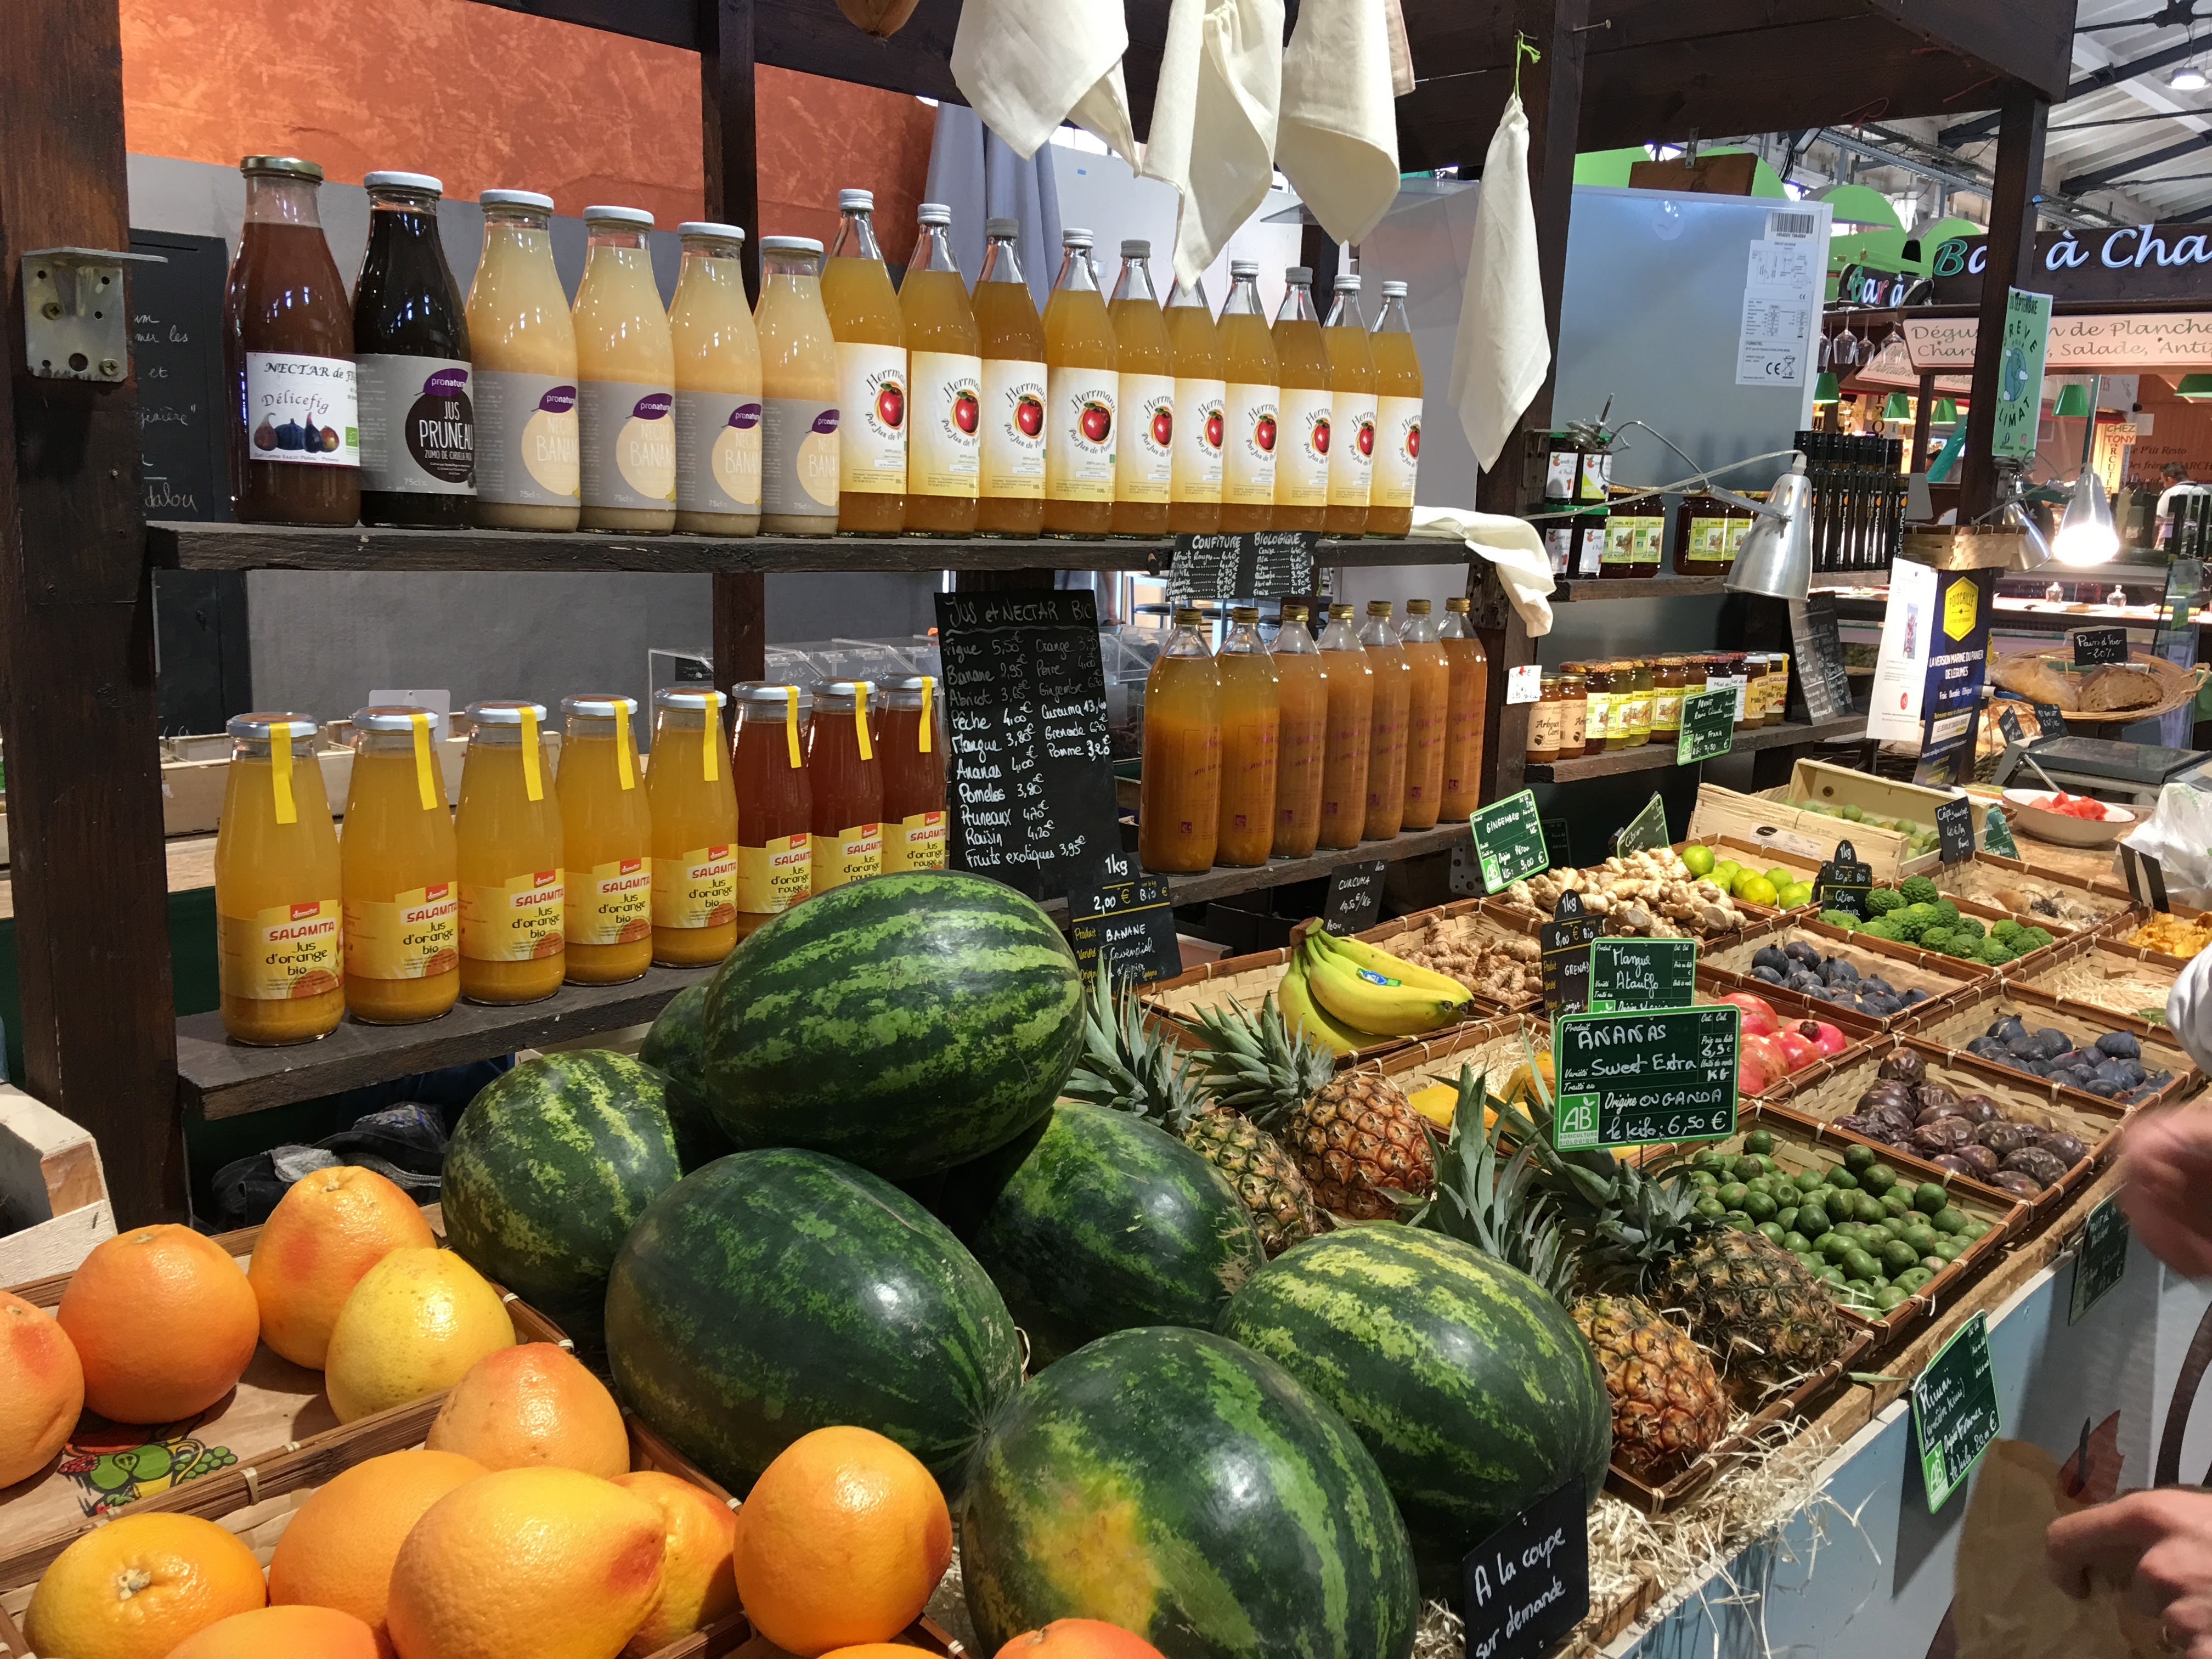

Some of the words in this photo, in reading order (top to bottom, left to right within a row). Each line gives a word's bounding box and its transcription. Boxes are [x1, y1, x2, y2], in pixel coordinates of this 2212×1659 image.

[2046, 230, 2089, 270] à
[1847, 266, 1889, 304] Bar
[2070, 321, 2104, 336] de
[149, 366, 168, 378] et
[264, 362, 331, 377] NECTAR
[332, 367, 343, 379] de
[261, 390, 330, 415] Délicefig
[1070, 389, 1116, 415] Herrmann
[444, 401, 460, 421] JUS
[865, 411, 876, 430] Pur
[872, 425, 887, 438] Jus
[888, 432, 896, 441] de
[941, 417, 952, 437] Pur
[948, 431, 962, 444] Jus
[963, 438, 970, 447] de
[1069, 427, 1080, 442] Pur
[2107, 424, 2136, 432] CHEZ
[1004, 421, 1015, 441] Pur
[1011, 435, 1024, 447] Jus
[1025, 441, 1033, 449] de
[1142, 432, 1152, 448] Pur
[2106, 435, 2135, 443] TONY
[1074, 441, 1089, 452] Jus
[1146, 445, 1159, 456] Jus
[945, 597, 978, 628] JUS
[985, 602, 999, 623] et
[1002, 598, 1059, 622] NECTAR
[944, 637, 982, 664] Figue
[1036, 639, 1075, 661] Orange
[2087, 648, 2114, 658] -20%
[946, 664, 996, 686] Banane
[949, 688, 993, 707] Abricot
[1039, 678, 1088, 703] Gingembre
[1042, 703, 1085, 720] Curcuma
[951, 710, 991, 731] Pêche
[1045, 721, 1086, 741] Grenade
[952, 733, 1003, 763] Mangue
[1047, 742, 1085, 758] Pomme
[1723, 738, 1730, 749] €
[957, 758, 1002, 780] Ananas
[960, 804, 1013, 827] Pruneaux
[907, 849, 943, 860] d'orange
[924, 842, 938, 851] Jus
[1840, 843, 1852, 860] 1kg
[861, 855, 875, 864] Jus
[965, 846, 1001, 868] Fruits
[1006, 843, 1055, 870] exotiques
[1538, 851, 1545, 864] €
[789, 866, 804, 876] Jus
[843, 862, 880, 874] d'orange
[1105, 854, 1128, 877] 1kg
[1486, 864, 1498, 882] AB
[602, 876, 650, 893] SALAMITA
[708, 879, 726, 889] Jus
[771, 873, 809, 885] d'orange
[619, 894, 639, 904] Jus
[689, 885, 733, 899] d'orange
[598, 900, 646, 914] d'orange
[705, 899, 719, 908] bio
[1093, 895, 1116, 915] 2,00
[1120, 888, 1131, 904] €
[1139, 887, 1156, 901] Bio
[1561, 893, 1577, 913] 1kg
[511, 913, 560, 929] d'orange
[534, 907, 553, 918] Jus
[616, 915, 631, 923] bio
[269, 921, 335, 941] SALAMITA
[426, 922, 446, 933] Jus
[530, 929, 546, 939] bio
[1106, 923, 1146, 943] BANANE
[403, 928, 454, 945] d'orange
[1555, 931, 1570, 948] 8,00
[1572, 926, 1579, 940] €
[1583, 927, 1594, 940] Bio
[292, 941, 316, 953] Jus
[422, 945, 439, 955] bio
[266, 950, 328, 964] d'orange
[1613, 946, 1651, 978] Mangue
[287, 966, 307, 976] bio
[1564, 1023, 1590, 1033] Produit
[1578, 1024, 1667, 1050] ANANAS
[1565, 1069, 1588, 1079] Variété
[1592, 1053, 1647, 1076] Sweet
[1652, 1053, 1697, 1071] Extra
[1564, 1082, 1585, 1092] Traité
[1707, 1068, 1730, 1082] KG
[1605, 1092, 1637, 1115] Origine
[1639, 1088, 1722, 1107] OUGANDA
[1562, 1106, 1592, 1132] AB
[1667, 1115, 1705, 1136] 6,50
[1711, 1110, 1727, 1130] €
[1559, 1138, 1599, 1146] BIOLOGIQUE
[1989, 1410, 1997, 1431] €
[1930, 1458, 1944, 1493] AB
[1475, 1565, 1492, 1607] A
[1497, 1552, 1516, 1585] la
[1522, 1527, 1566, 1568] coupe
[1476, 1628, 1500, 1659] sur
[1506, 1575, 1566, 1639] demande
